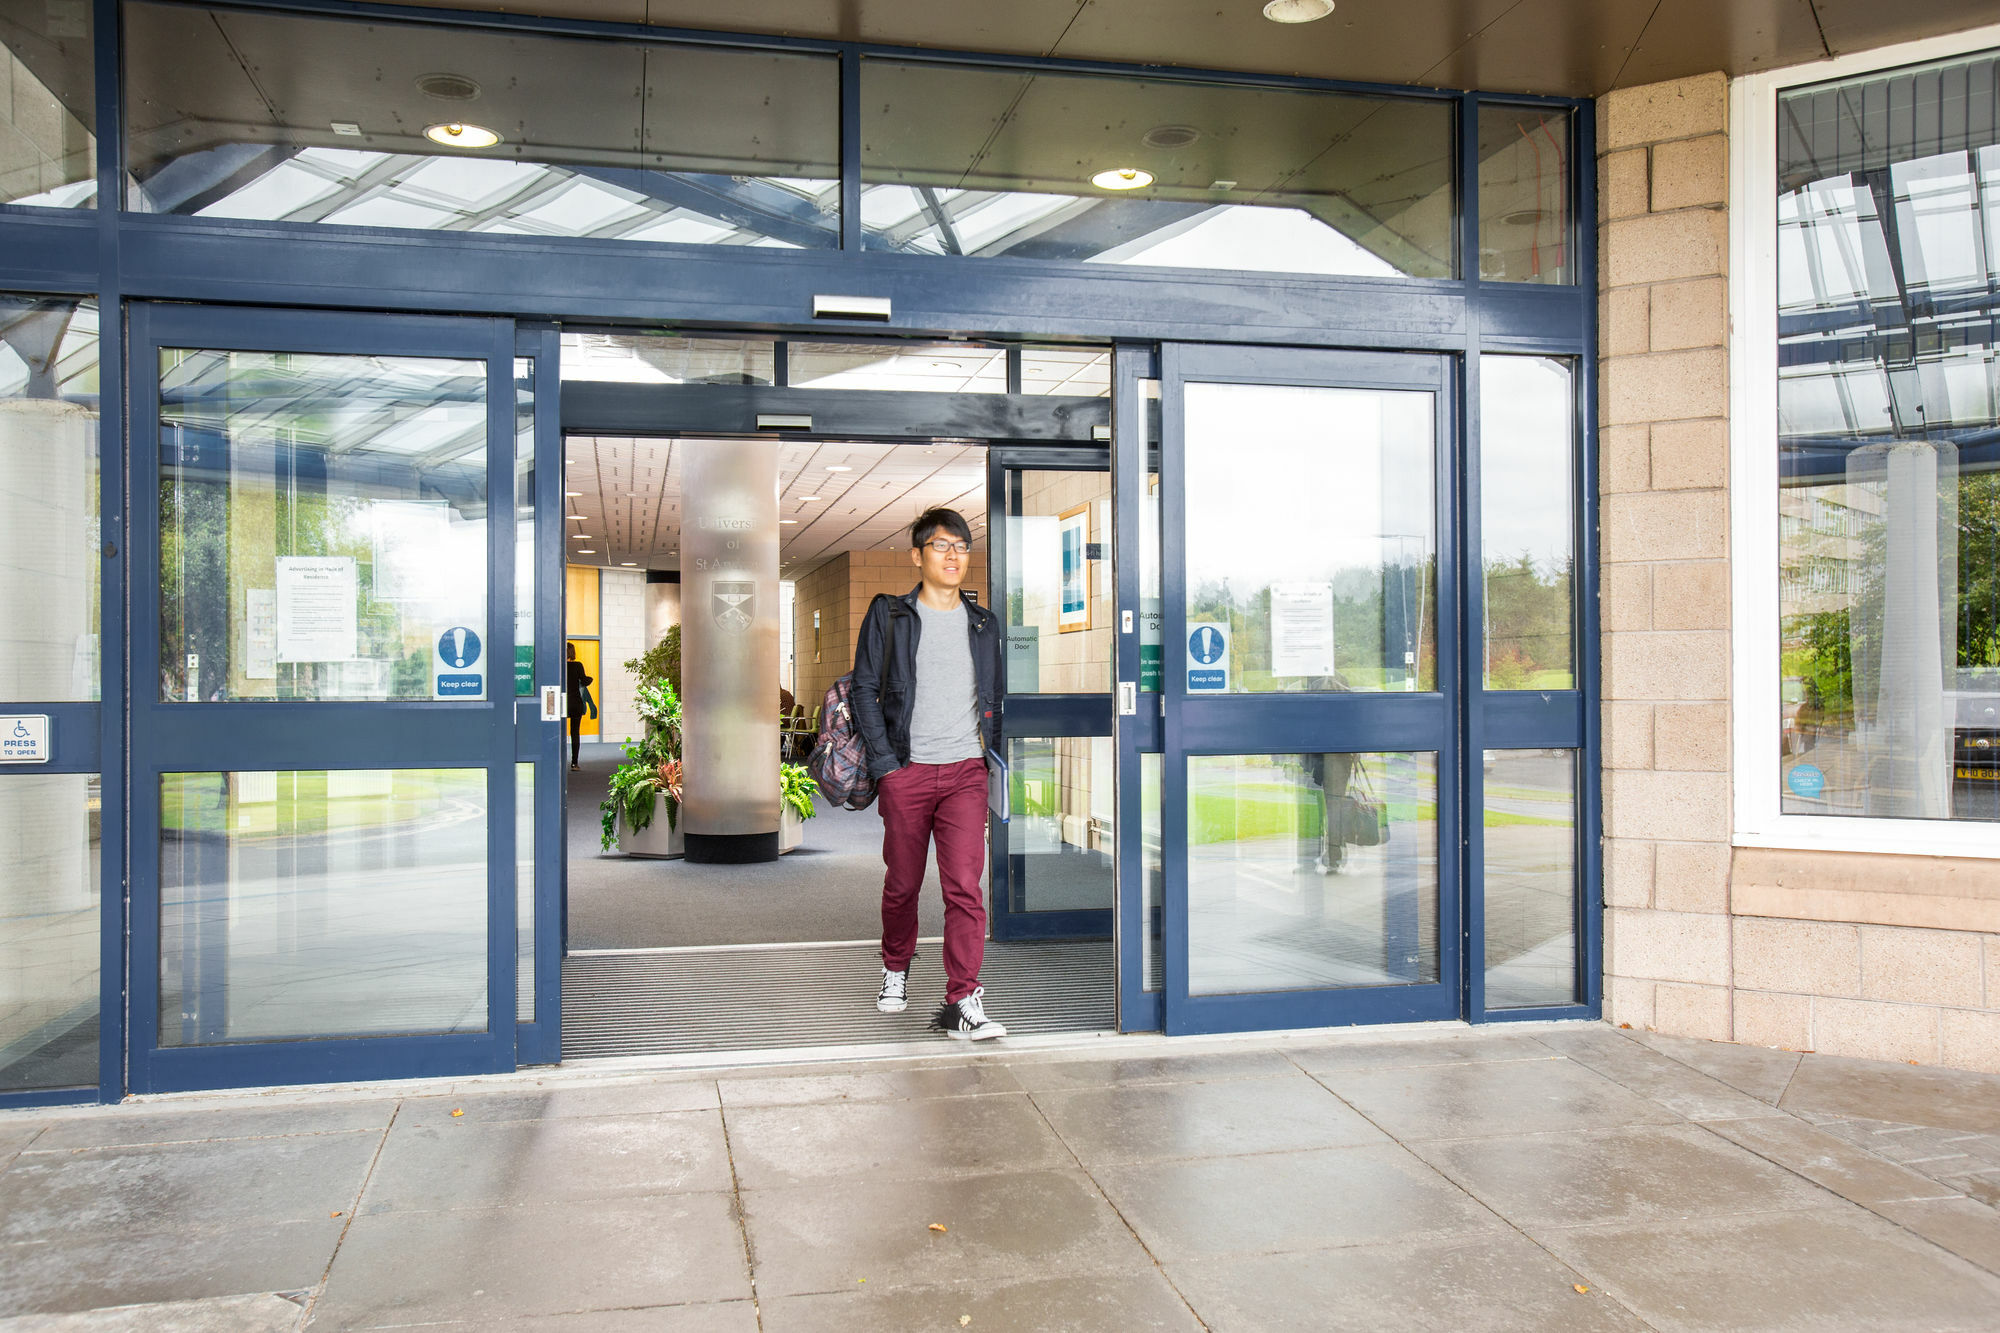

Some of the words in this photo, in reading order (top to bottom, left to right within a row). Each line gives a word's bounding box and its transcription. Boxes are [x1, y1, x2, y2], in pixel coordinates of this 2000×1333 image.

[695, 557, 708, 570] St
[1191, 675, 1207, 683] Keep
[441, 680, 459, 689] Keep
[461, 680, 479, 688] clear
